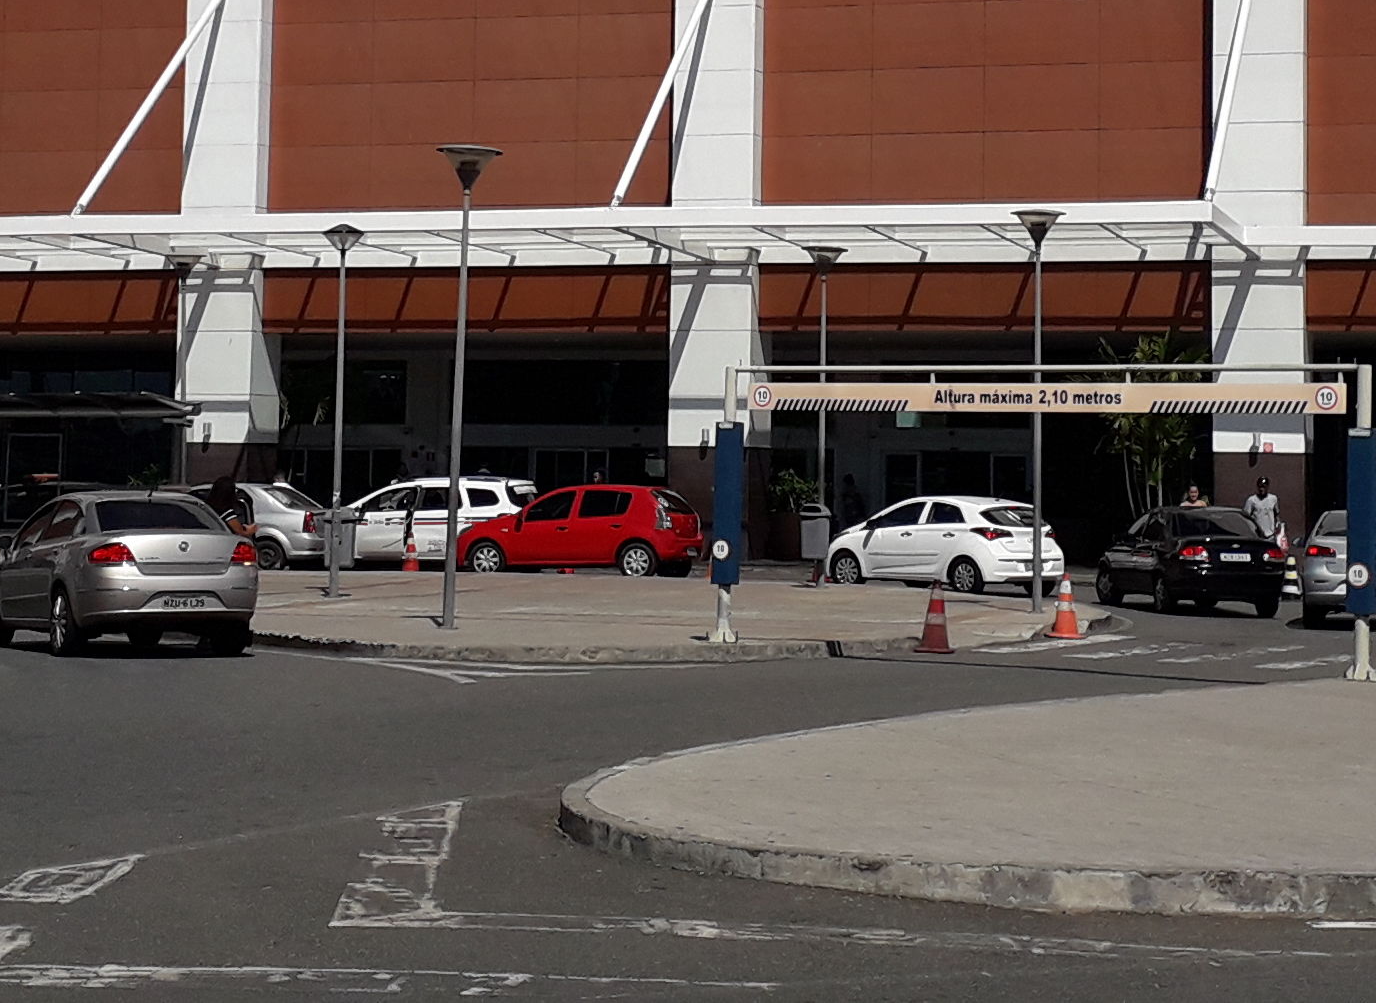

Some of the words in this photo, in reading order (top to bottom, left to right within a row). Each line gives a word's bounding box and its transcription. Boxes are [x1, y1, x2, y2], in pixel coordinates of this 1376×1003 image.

[757, 390, 768, 400] 10
[934, 389, 975, 405] Altura
[980, 389, 1033, 405] máxima
[1038, 389, 1068, 407] 2,10
[1073, 391, 1122, 405] metros
[1319, 391, 1333, 402] 10
